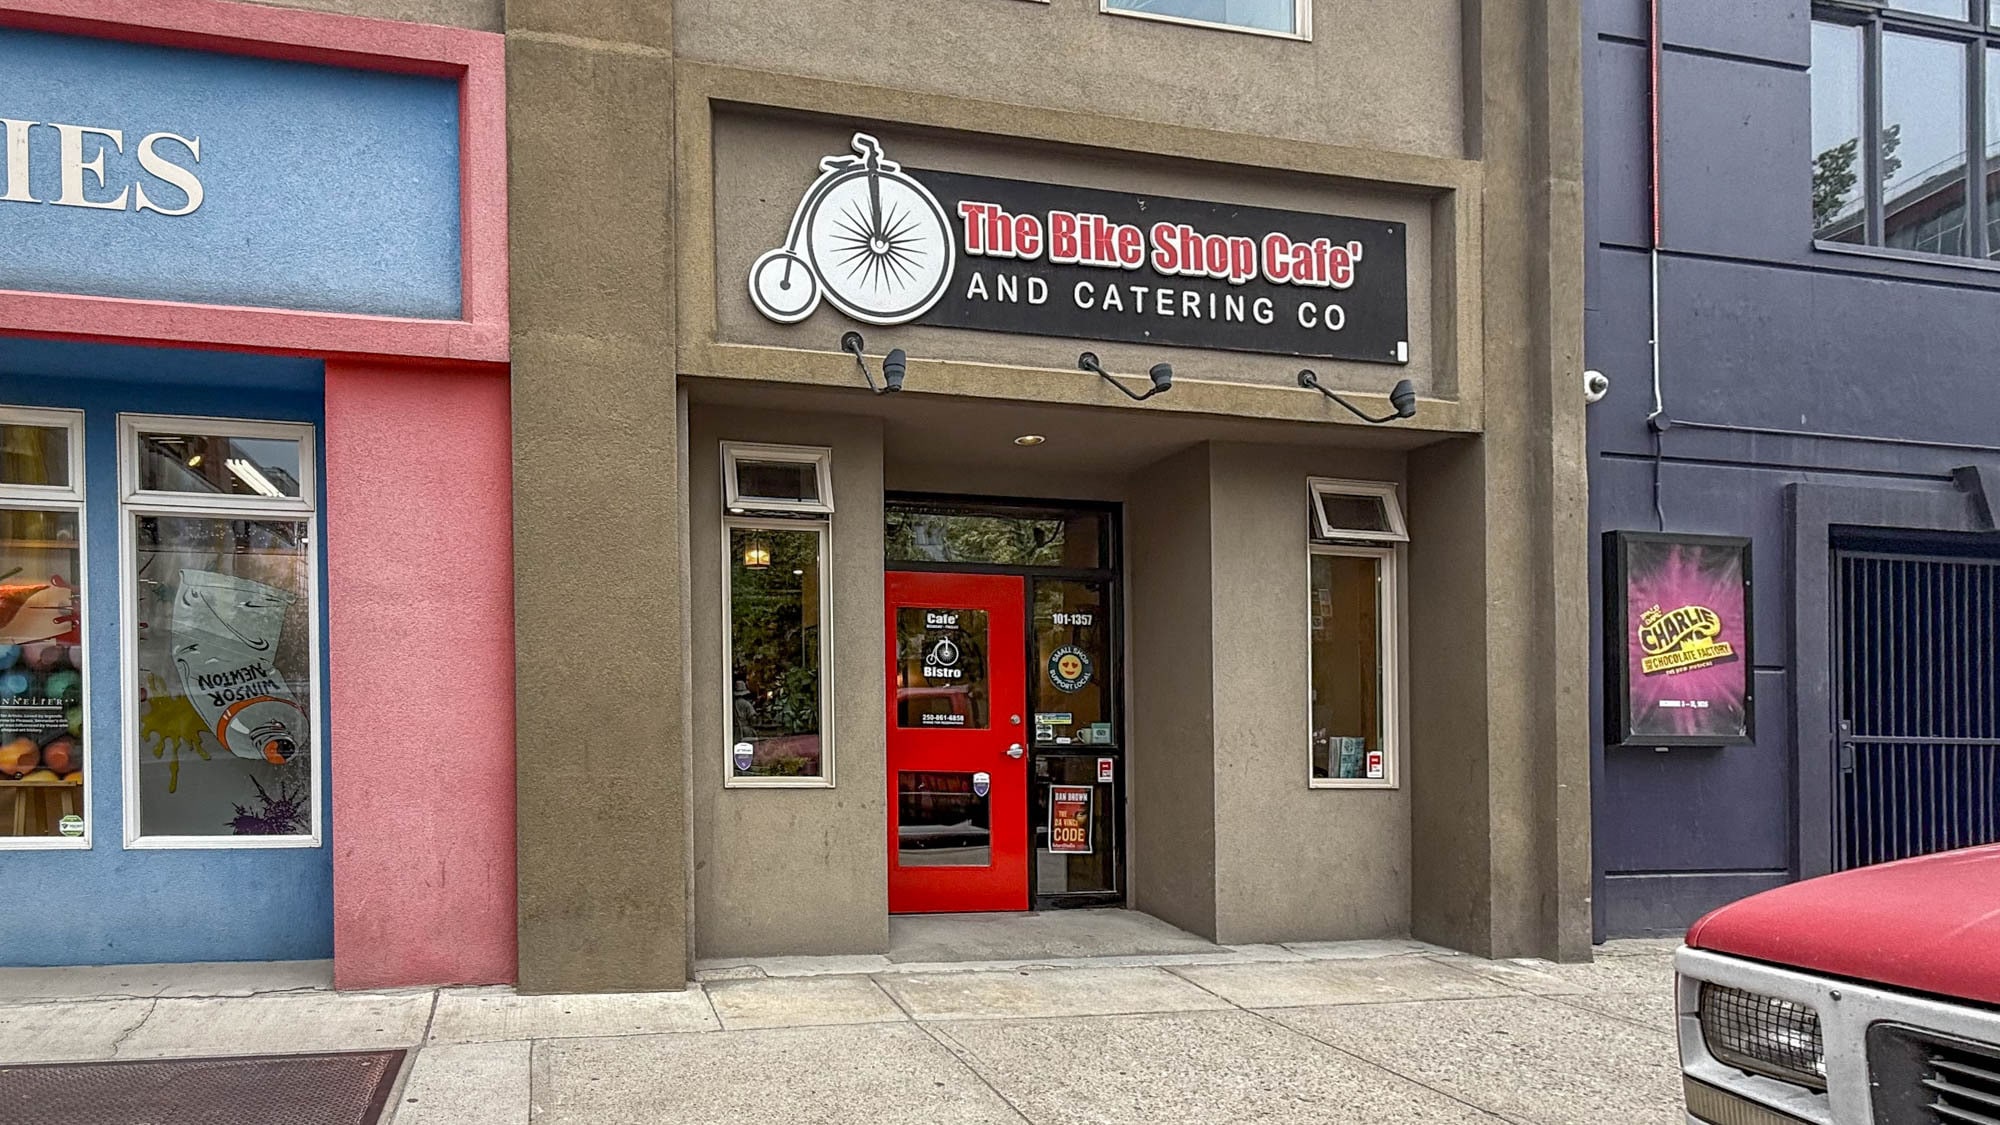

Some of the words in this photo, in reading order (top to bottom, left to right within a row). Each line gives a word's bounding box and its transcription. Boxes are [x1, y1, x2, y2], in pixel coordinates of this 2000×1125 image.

[0, 118, 204, 216] IES
[958, 201, 1043, 259] The
[1048, 211, 1144, 269] Bike
[1150, 222, 1257, 284] Shop
[1261, 232, 1361, 290] Cafe'
[967, 271, 1048, 305] AND
[1074, 281, 1274, 325] CATERING
[1299, 302, 1346, 331] CO
[1052, 613, 1093, 626] 101-1357
[1641, 608, 1715, 651] CHARLIE
[1052, 647, 1072, 663] SMALL
[1073, 647, 1089, 665] SHOP
[1652, 650, 1696, 668] CHOCOLATE
[1697, 644, 1729, 659] FACTORY
[198, 662, 268, 691] NEWTON
[923, 666, 962, 678] Bistro
[1049, 669, 1073, 690] SUPPORT
[1074, 672, 1091, 689] LOCAL
[207, 679, 281, 707] WINSOR
[1068, 793, 1088, 801] BROWN
[1054, 828, 1085, 842] CODE
